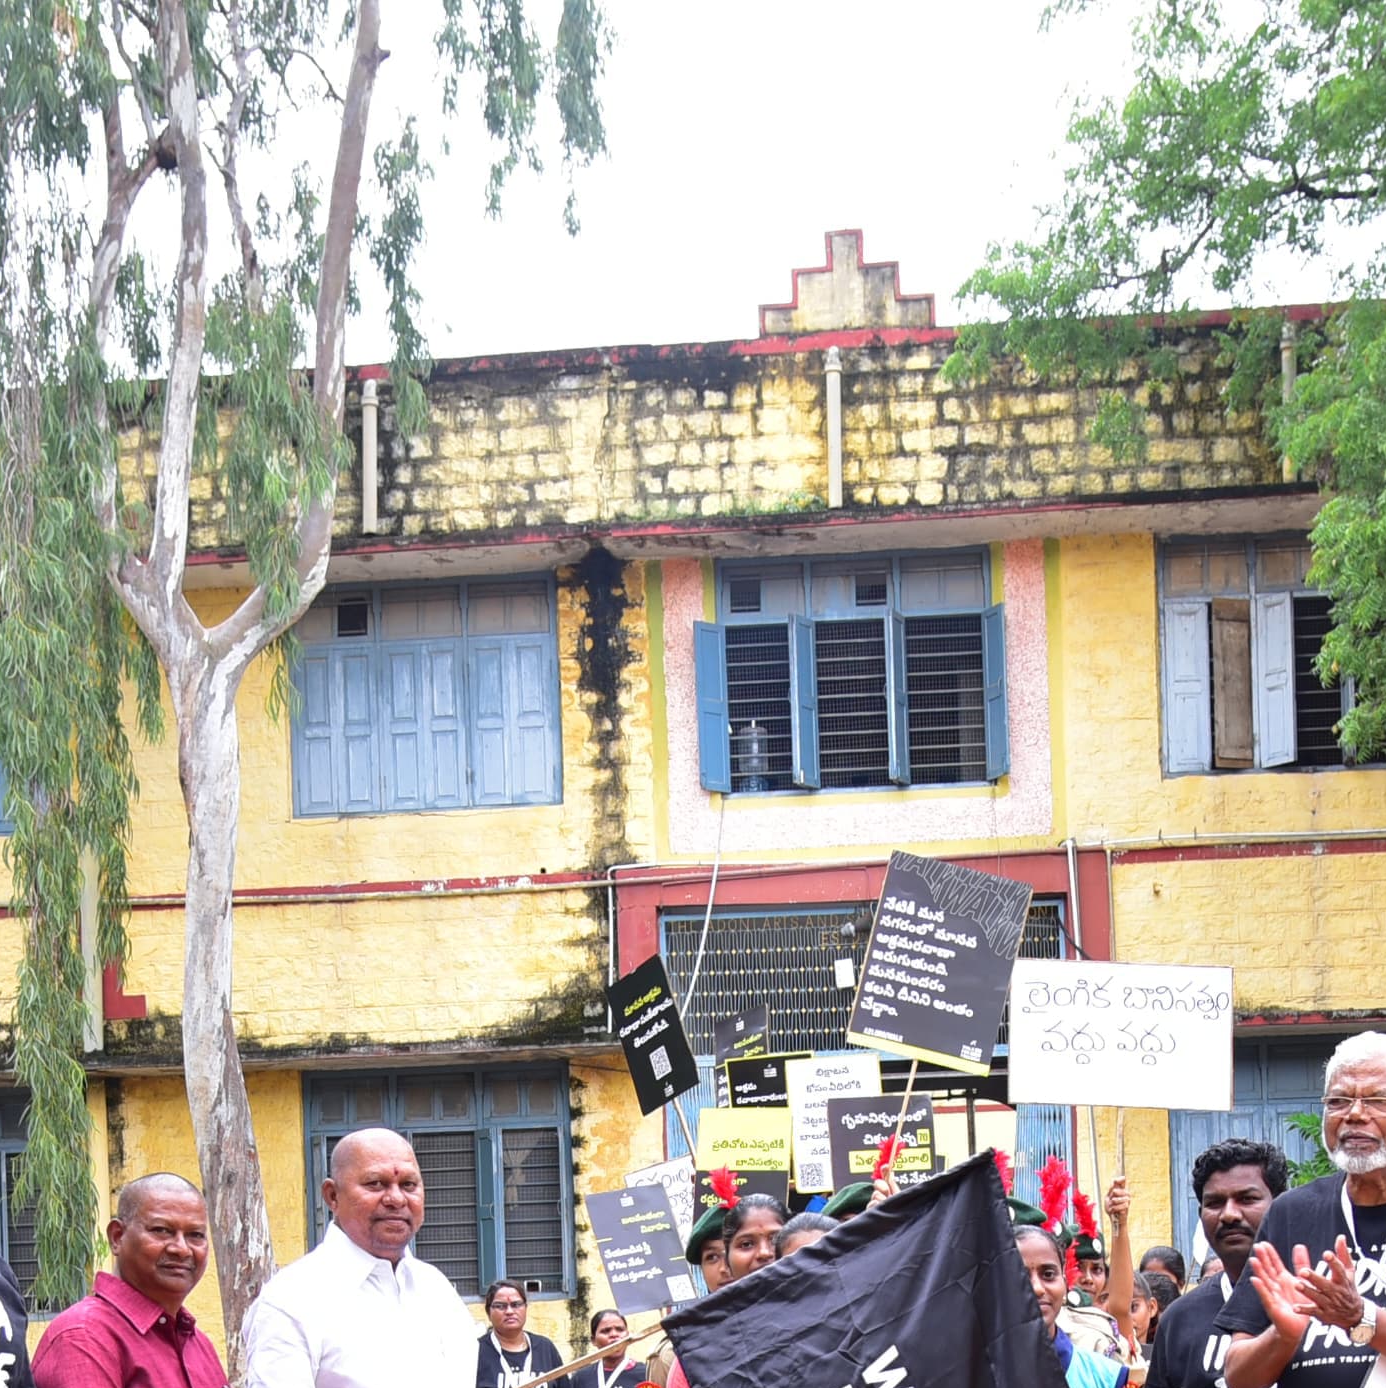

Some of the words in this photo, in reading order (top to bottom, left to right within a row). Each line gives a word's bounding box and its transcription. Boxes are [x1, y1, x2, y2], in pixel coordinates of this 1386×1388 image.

[918, 906, 945, 923] మన
[879, 914, 935, 935] నగరంలో
[934, 928, 977, 948] మానవ
[1041, 1020, 1106, 1065] వద్దు
[1117, 1021, 1177, 1066] వద్దు
[1301, 1356, 1335, 1368] HUMAN
